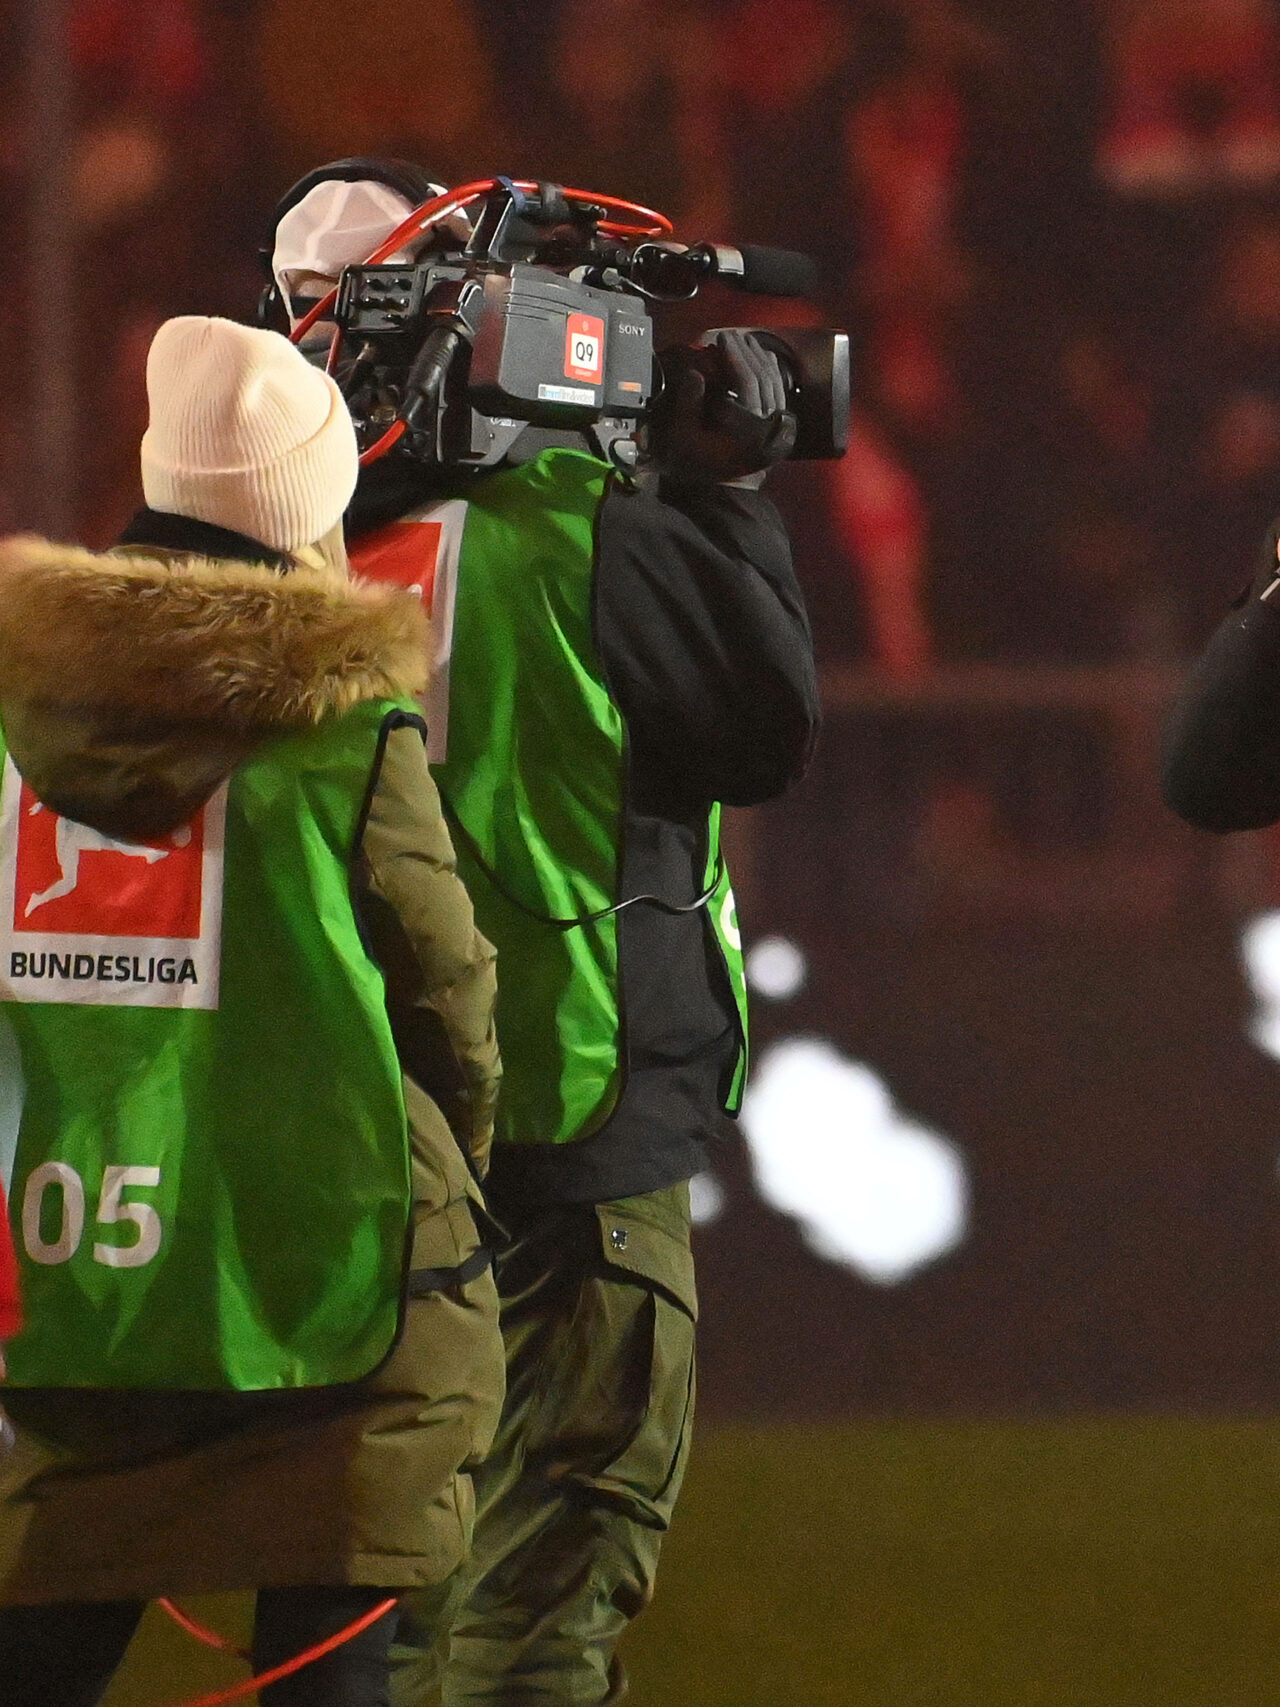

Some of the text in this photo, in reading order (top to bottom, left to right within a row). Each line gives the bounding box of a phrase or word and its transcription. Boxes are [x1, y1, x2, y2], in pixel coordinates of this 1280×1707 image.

[619, 324, 645, 336] SONY
[576, 341, 593, 362] Q9
[10, 952, 198, 984] BUNDESLIGA
[22, 1161, 162, 1268] 05
